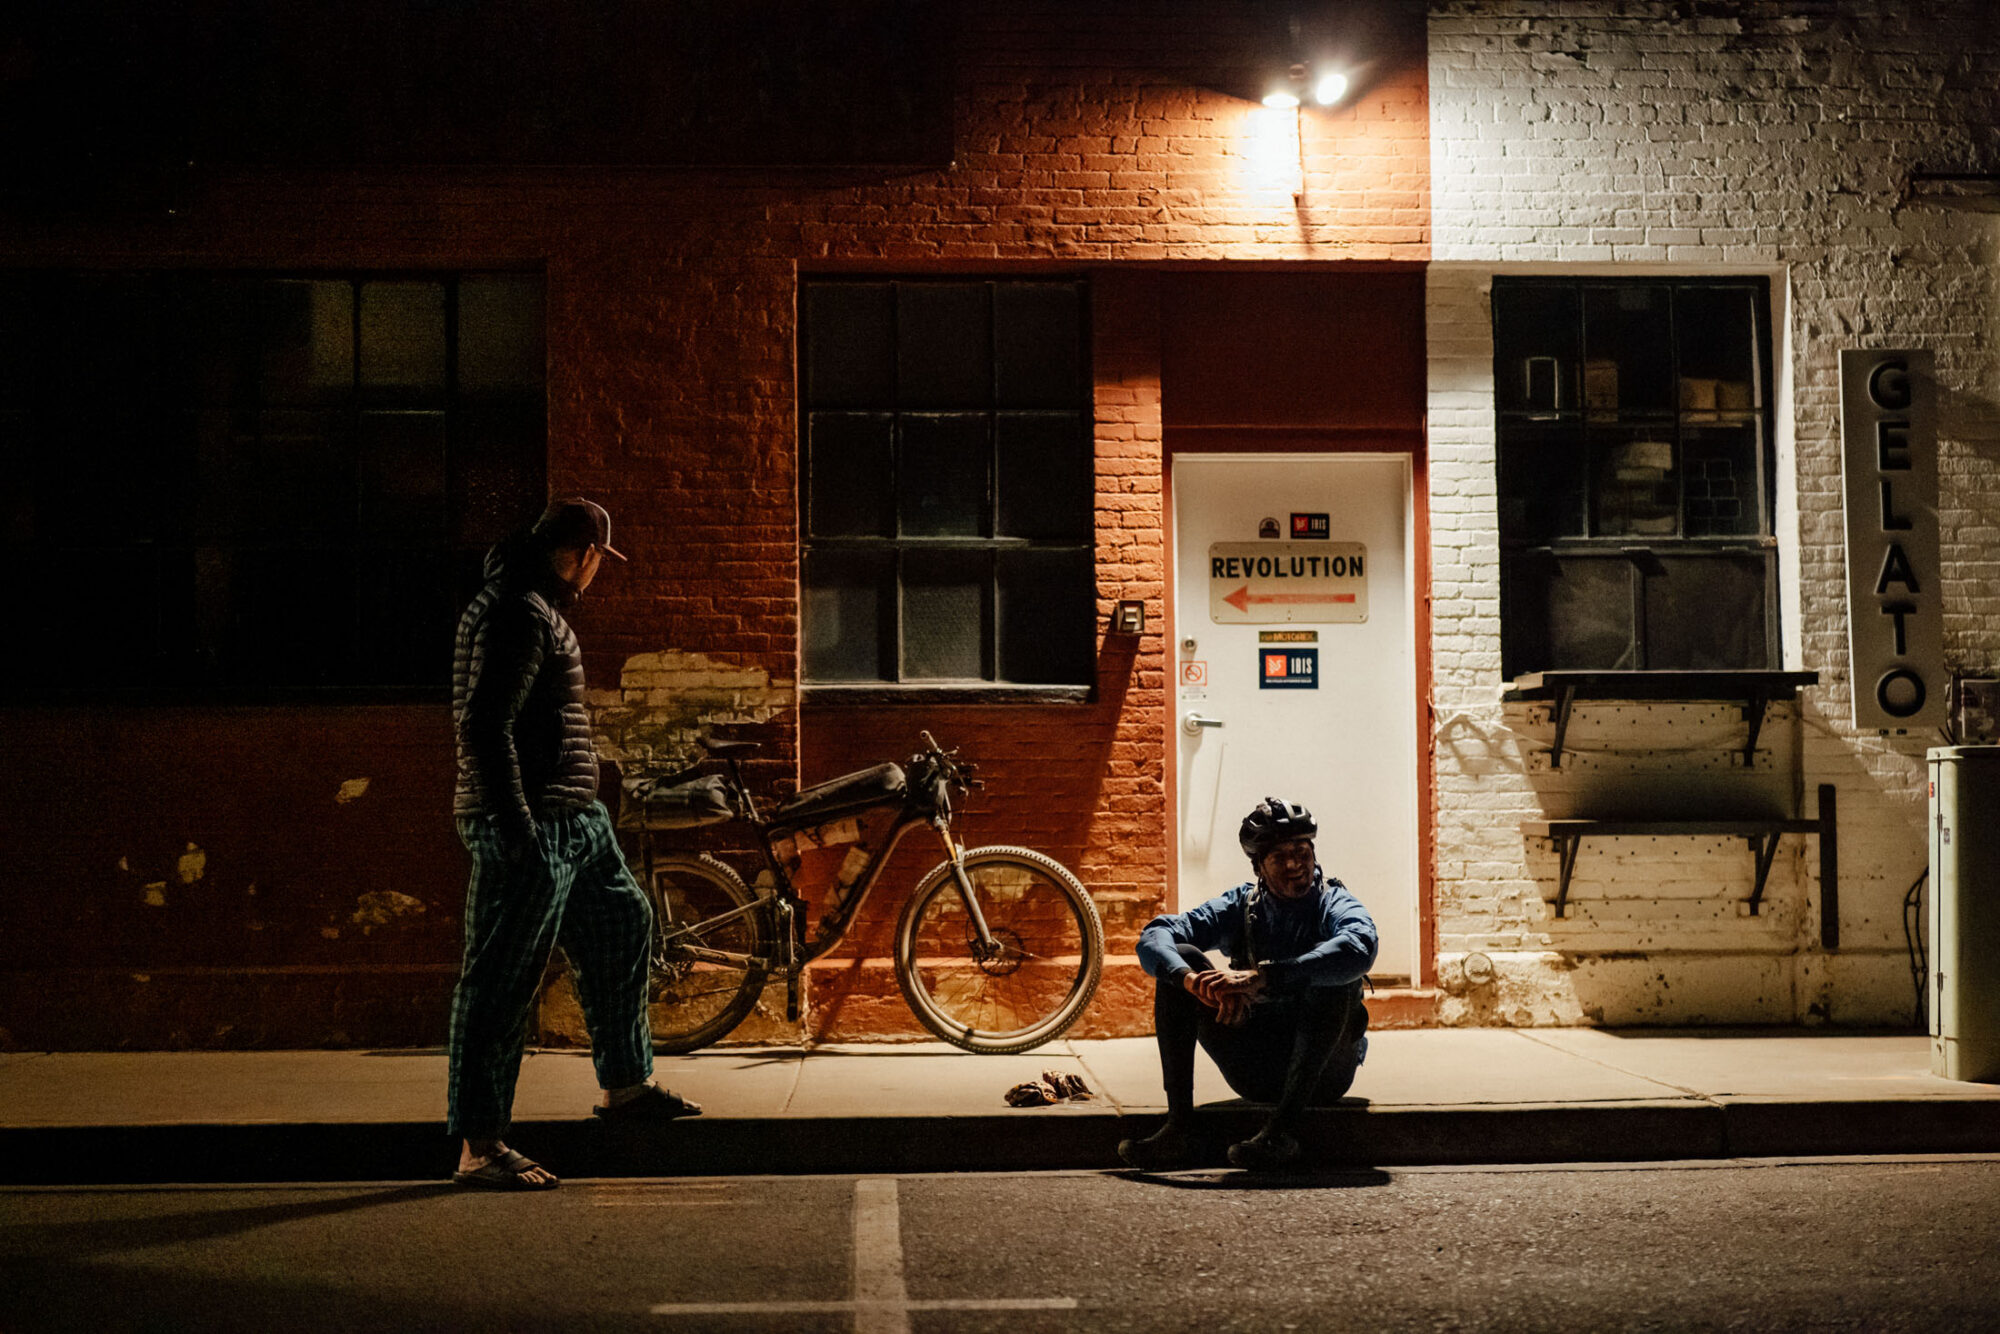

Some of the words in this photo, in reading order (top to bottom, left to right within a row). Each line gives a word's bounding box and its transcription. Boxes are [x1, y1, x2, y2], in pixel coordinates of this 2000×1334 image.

[1867, 360, 1927, 718] GELATO
[1211, 556, 1364, 578] REVOLUTION
[1291, 657, 1312, 674] IBIS
